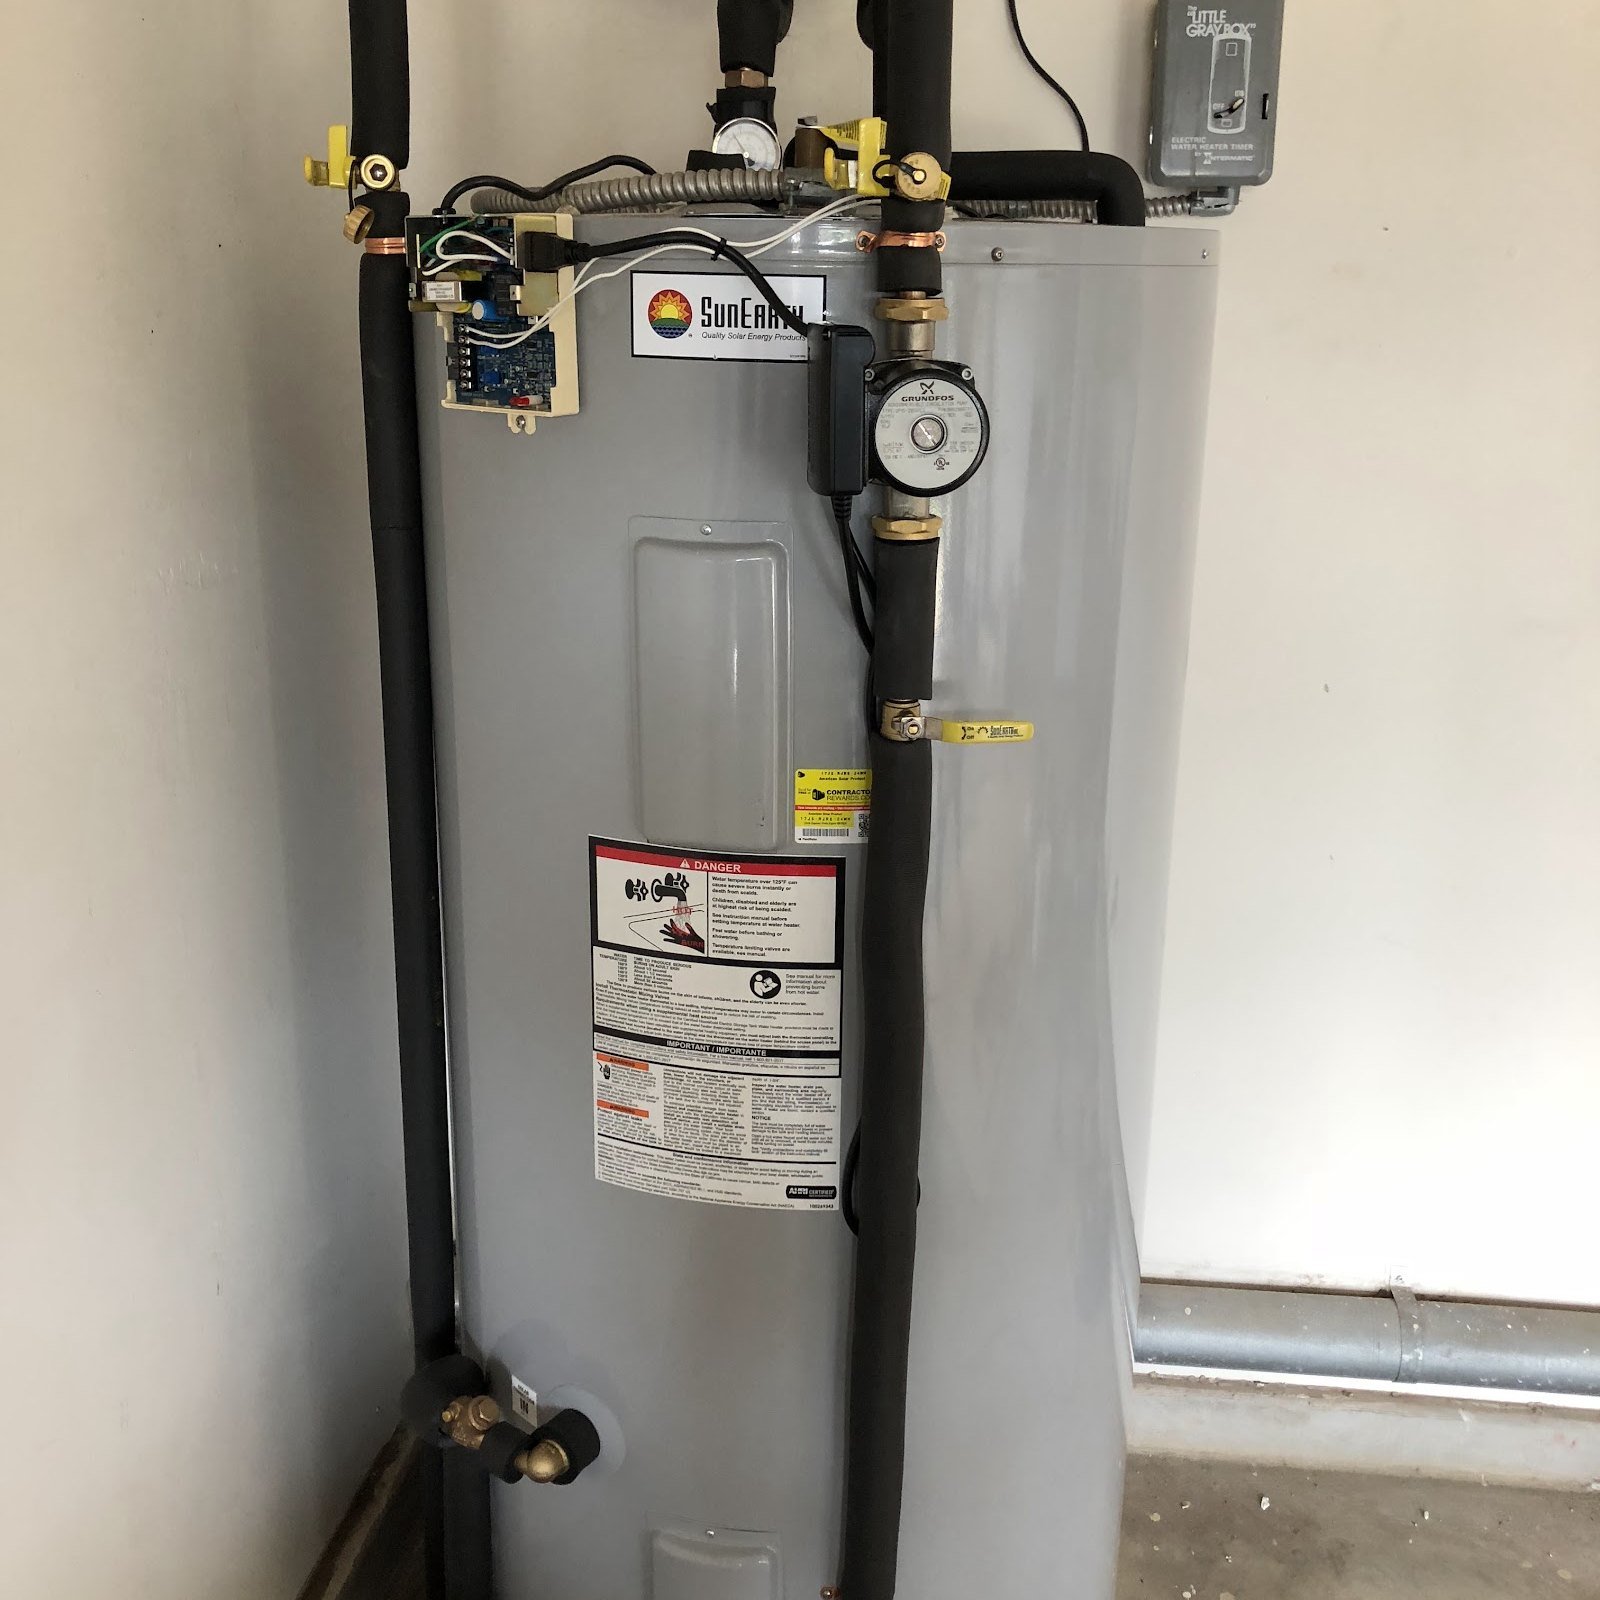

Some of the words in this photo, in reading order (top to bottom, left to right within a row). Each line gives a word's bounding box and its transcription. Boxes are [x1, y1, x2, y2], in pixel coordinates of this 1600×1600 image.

[1186, 23, 1222, 37] GRAY
[702, 332, 725, 340] Quality
[748, 333, 773, 341] Energy
[694, 861, 742, 873] DANGER
[667, 1041, 710, 1052] IMPORTANT
[716, 1046, 767, 1056] IMPORTANTE
